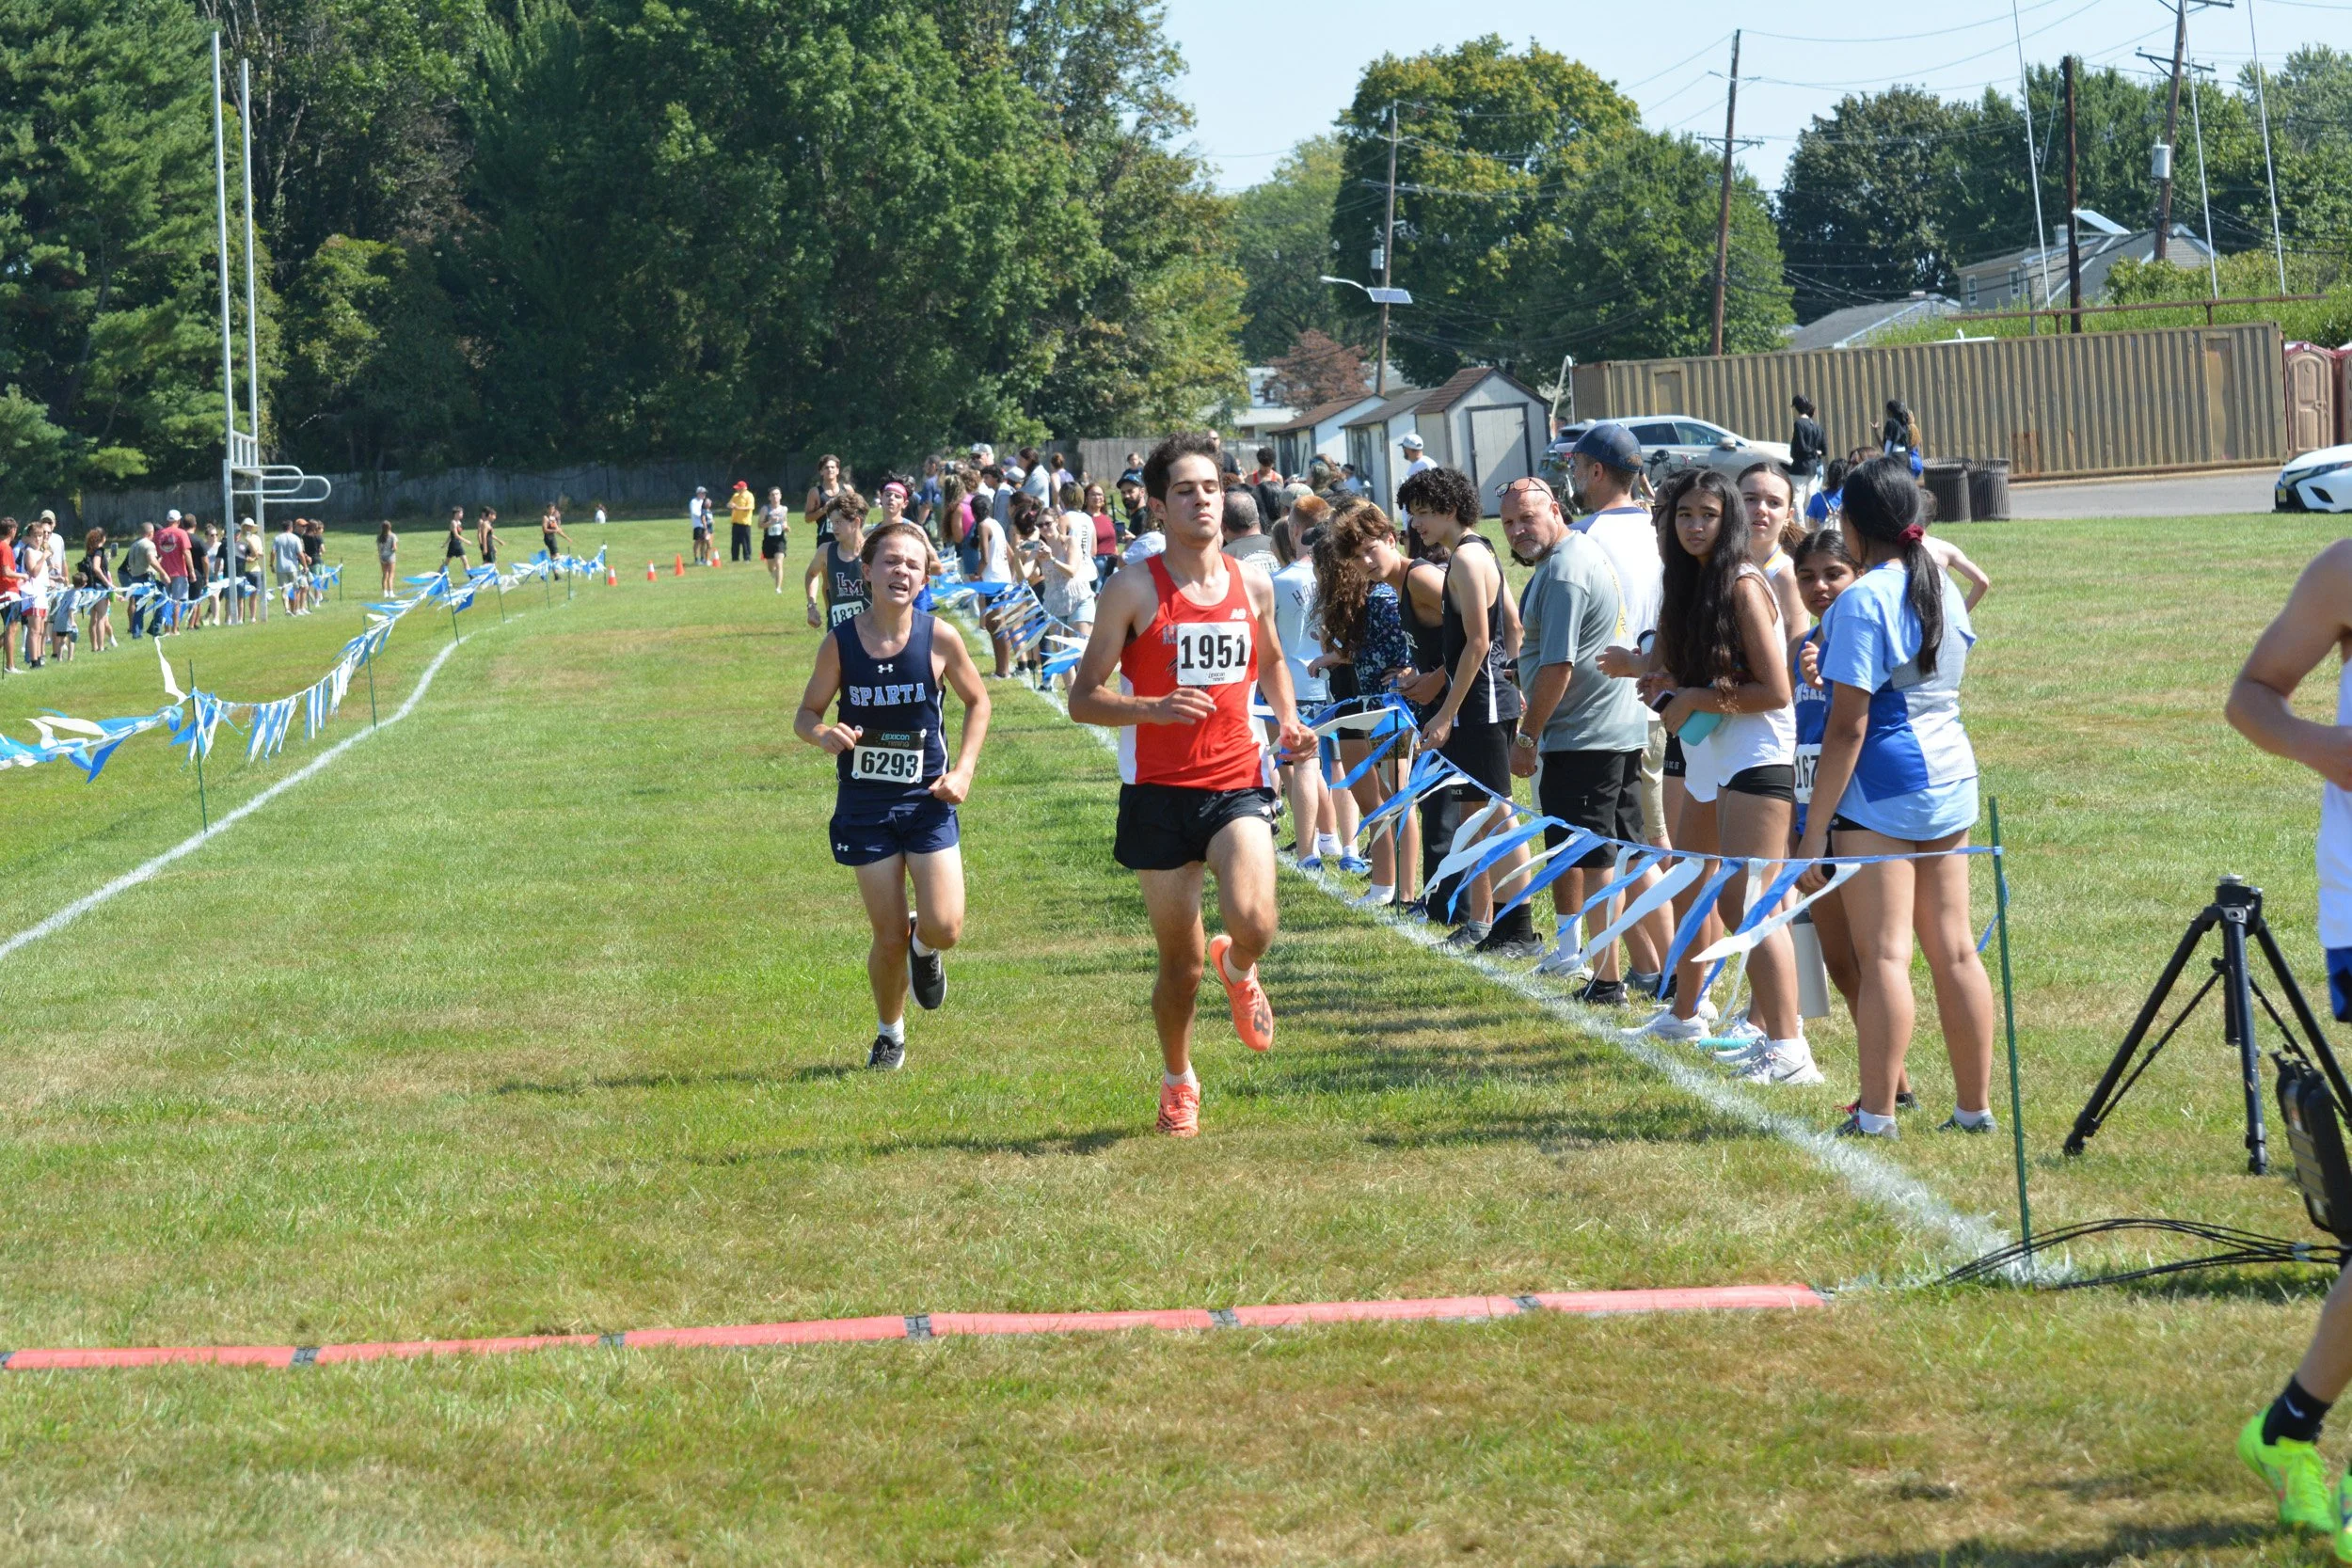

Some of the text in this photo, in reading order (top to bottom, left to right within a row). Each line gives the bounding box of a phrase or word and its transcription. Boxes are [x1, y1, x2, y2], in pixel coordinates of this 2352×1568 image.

[1181, 634, 1247, 669] 1951
[849, 682, 927, 706] SPARTA
[860, 751, 919, 778] 6293
